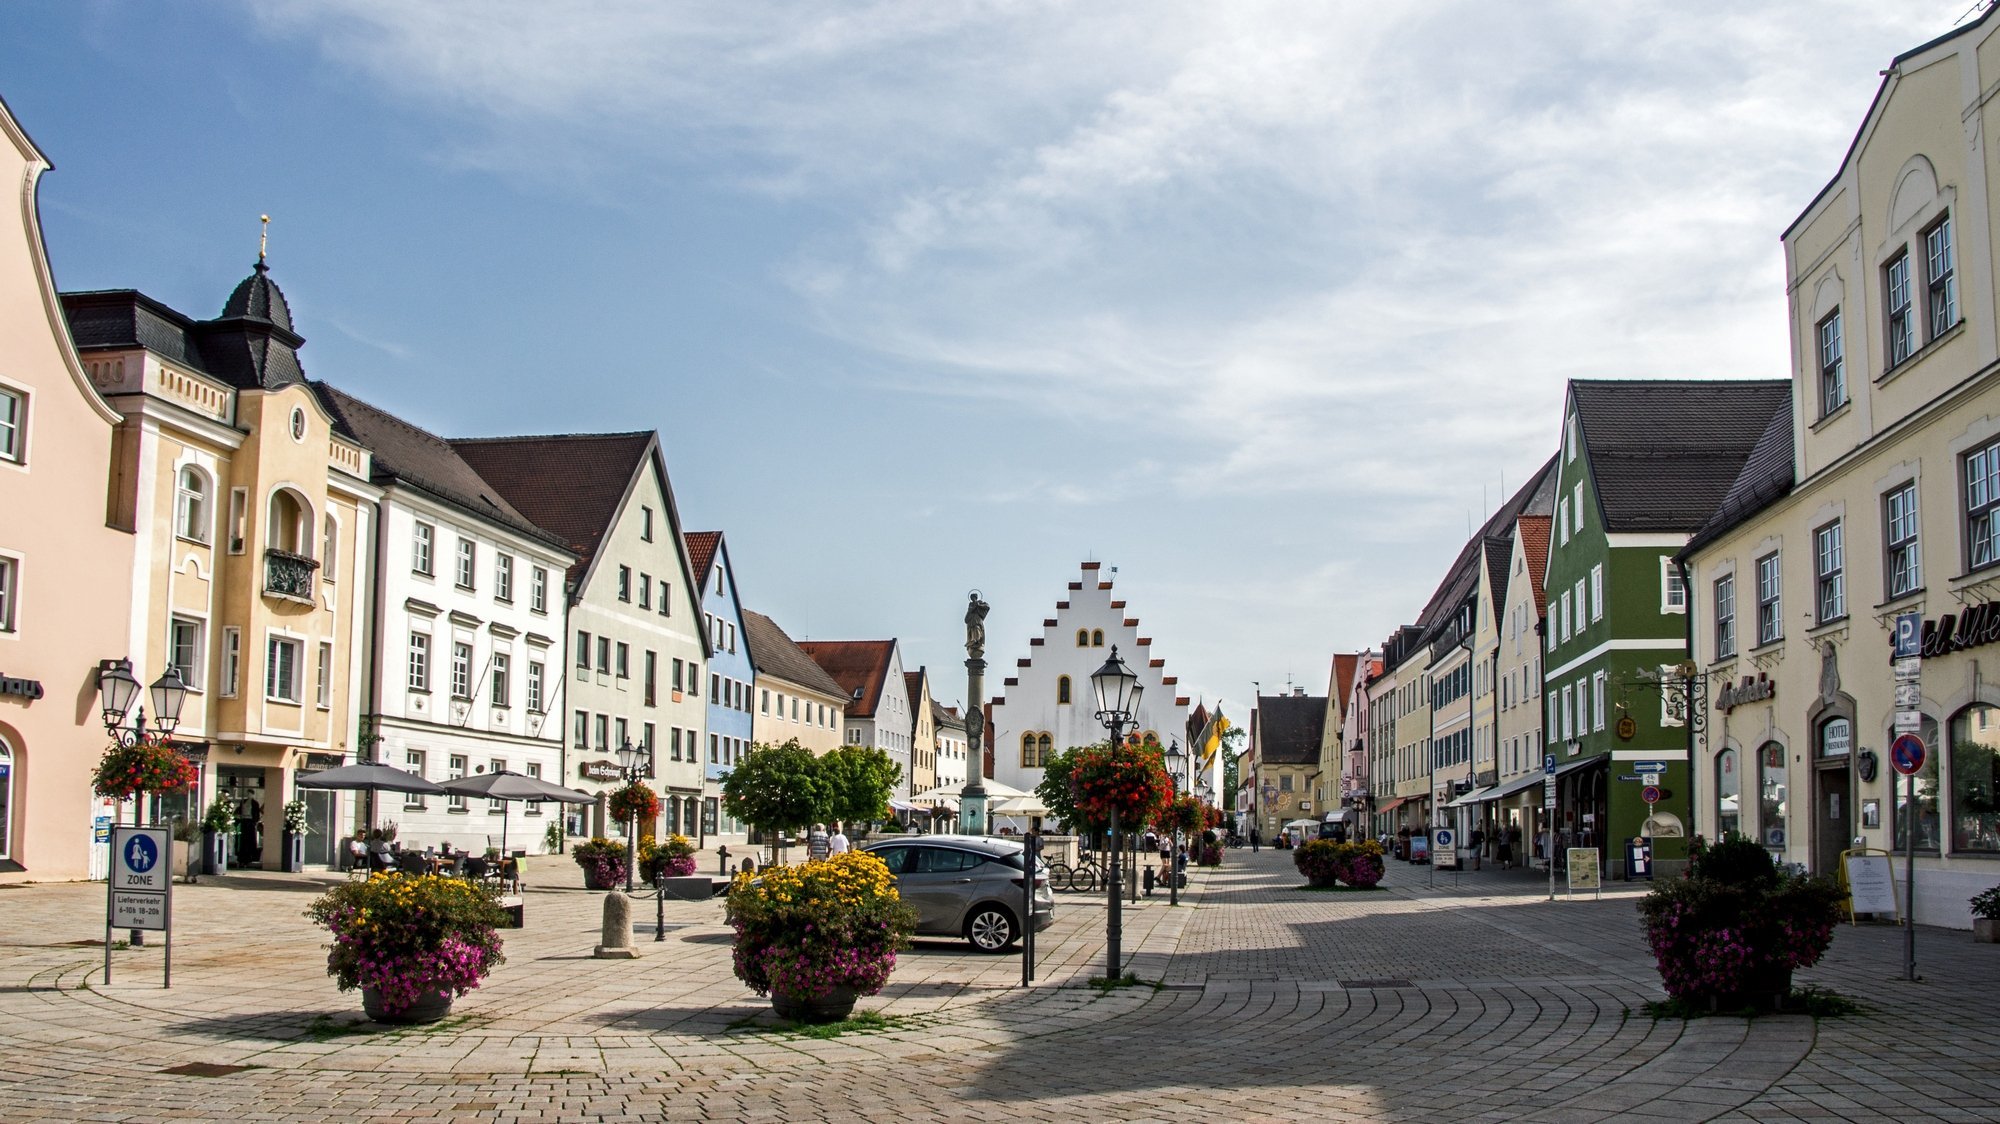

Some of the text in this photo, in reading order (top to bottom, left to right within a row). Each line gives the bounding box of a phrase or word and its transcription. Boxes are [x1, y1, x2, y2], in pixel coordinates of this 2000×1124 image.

[1900, 620, 1913, 651] P
[1828, 725, 1848, 739] HOTEL
[1546, 757, 1552, 772] P
[127, 875, 152, 885] ZONE
[117, 896, 160, 905] Lieferverkehr
[138, 907, 160, 915] 18-20h
[133, 917, 144, 925] frei
